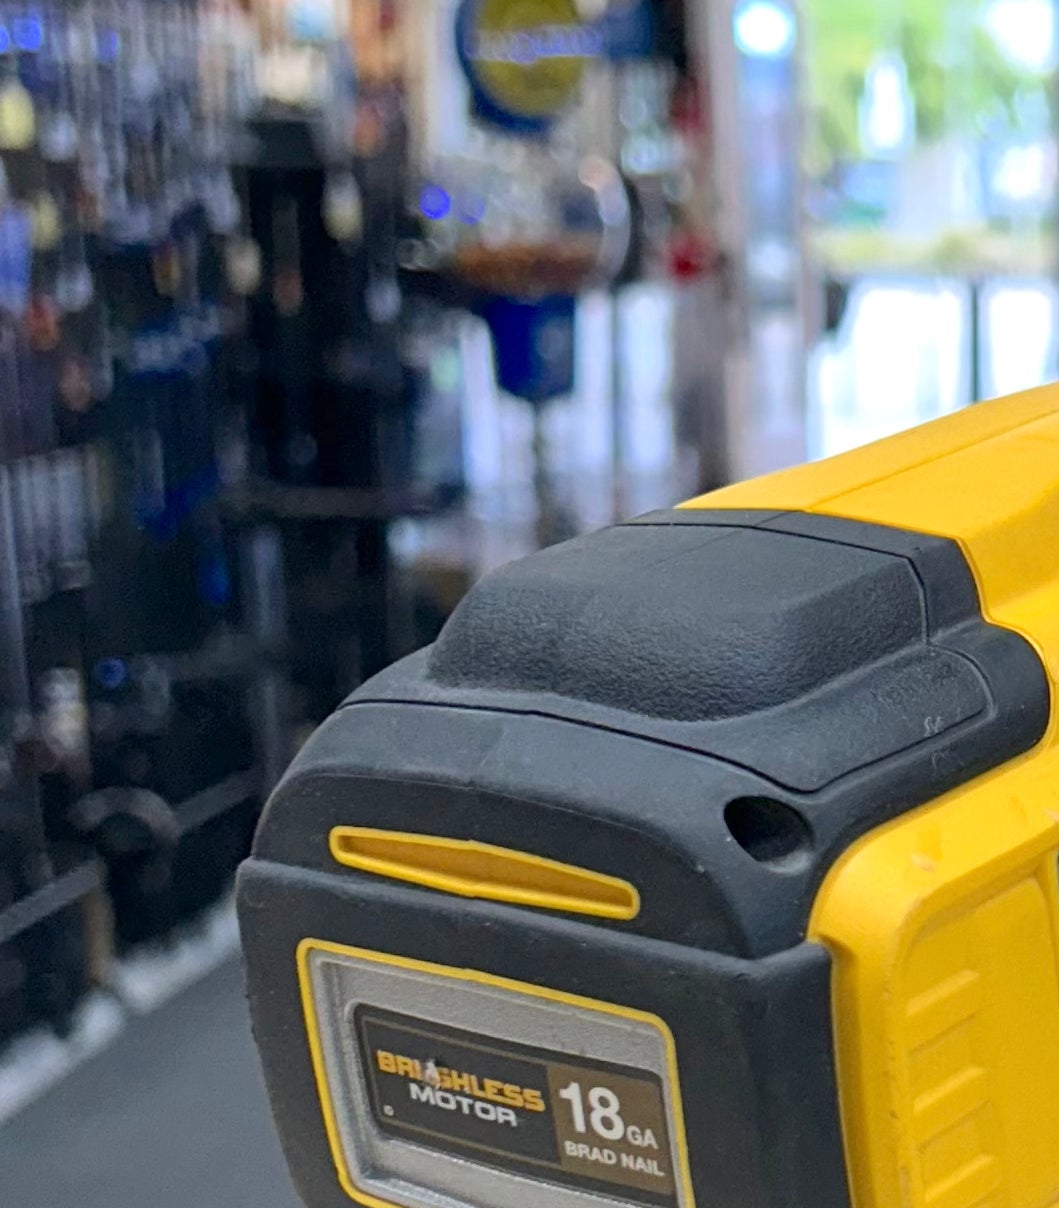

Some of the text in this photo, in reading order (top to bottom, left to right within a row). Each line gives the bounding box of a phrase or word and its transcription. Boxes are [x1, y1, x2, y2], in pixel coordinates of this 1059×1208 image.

[408, 1082, 518, 1127] MOTOR
[564, 1140, 666, 1177] BRAD NAIL
